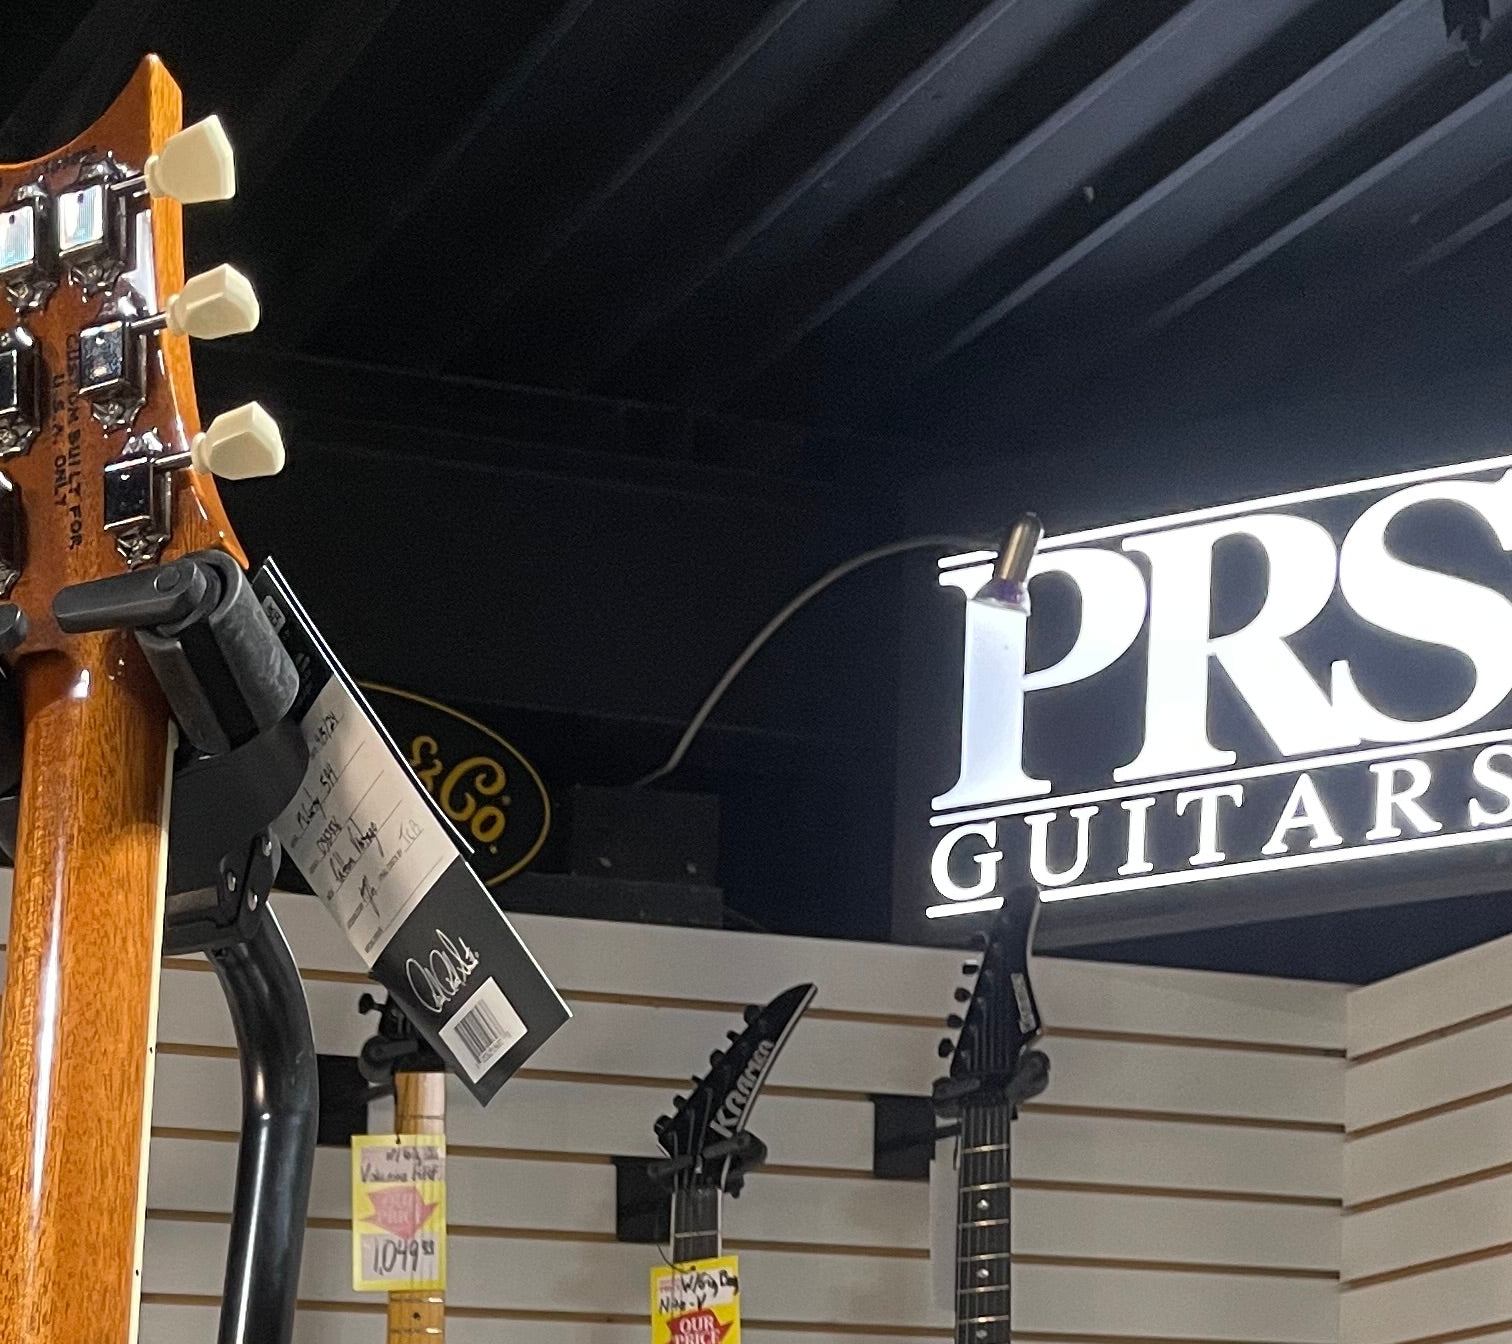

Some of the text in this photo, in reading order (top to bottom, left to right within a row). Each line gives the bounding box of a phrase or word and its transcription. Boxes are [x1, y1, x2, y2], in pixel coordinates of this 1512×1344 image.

[54, 454, 68, 507] ONLY
[68, 429, 81, 496] BUILT
[69, 504, 83, 550] FOR
[931, 467, 1512, 812] PRS
[929, 742, 1512, 903] GUITARS
[710, 1039, 775, 1139] KRAMER
[678, 1314, 715, 1334] OUR
